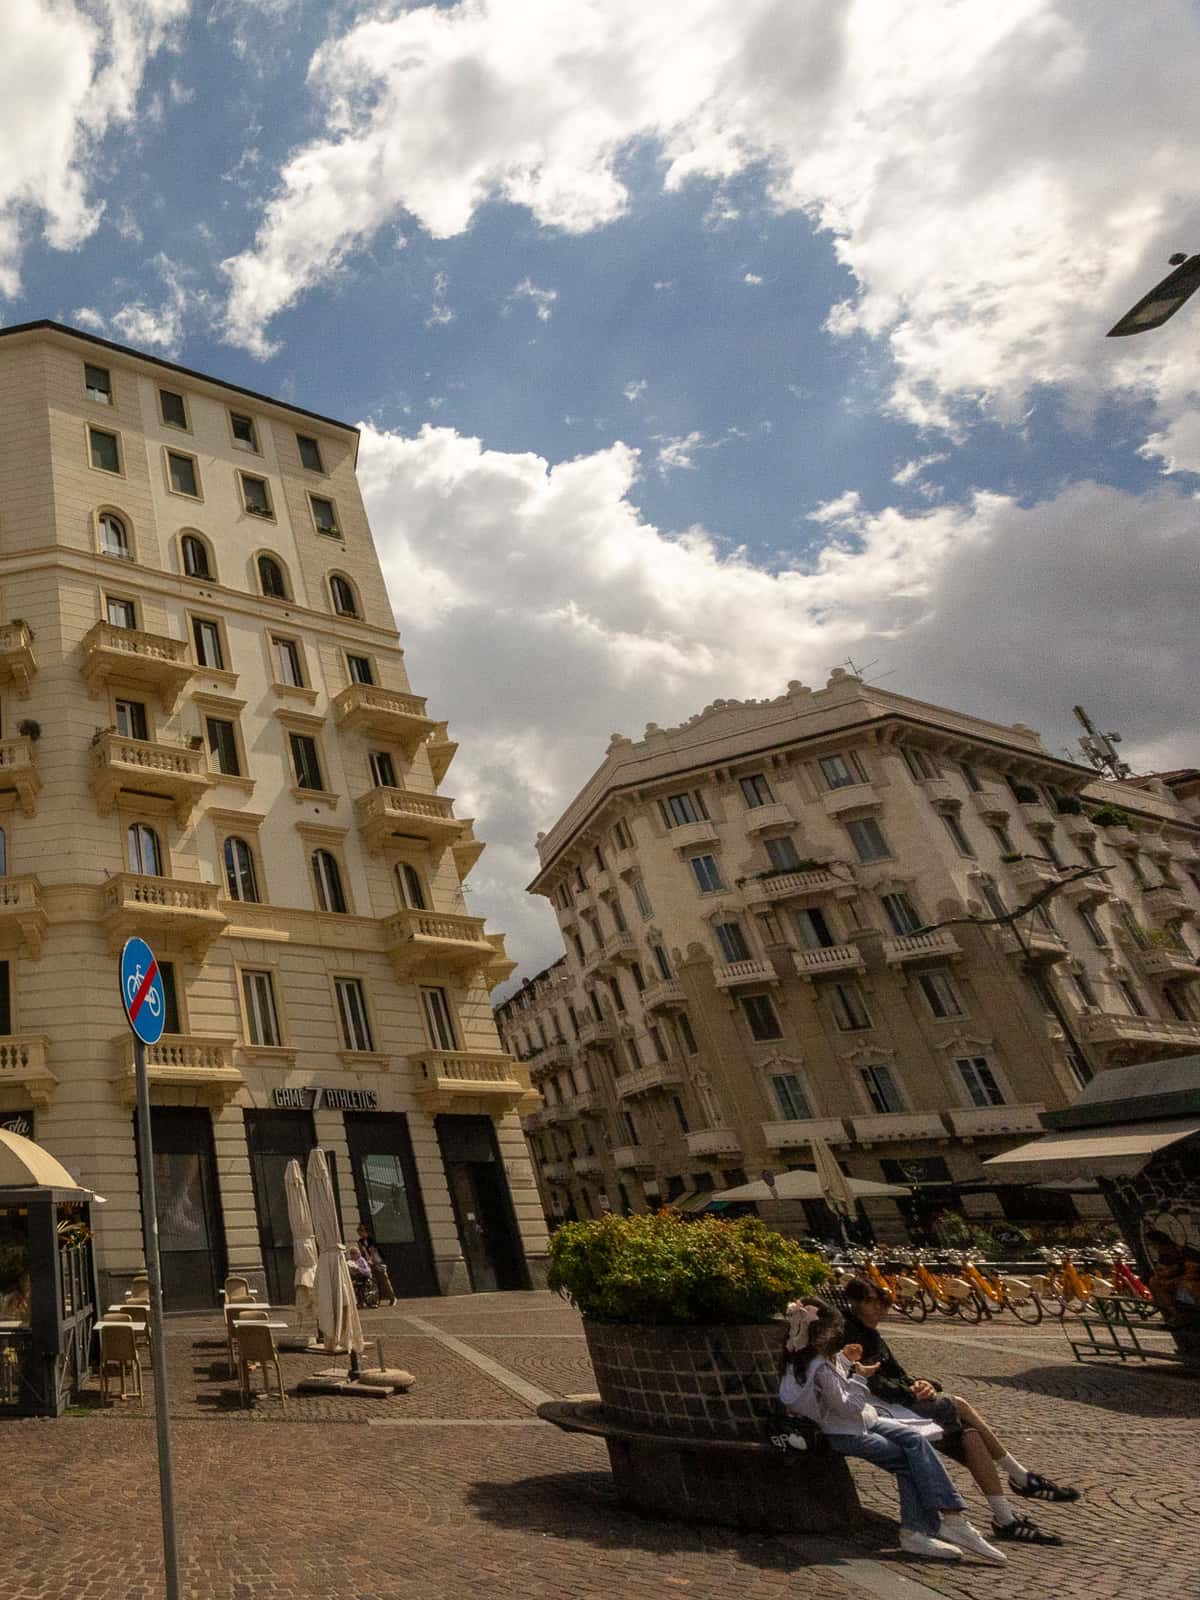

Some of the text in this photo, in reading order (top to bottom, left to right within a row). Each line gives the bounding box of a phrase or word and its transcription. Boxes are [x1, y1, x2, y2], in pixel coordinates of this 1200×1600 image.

[274, 1087, 377, 1112] GAME 7 ATHLETICS
